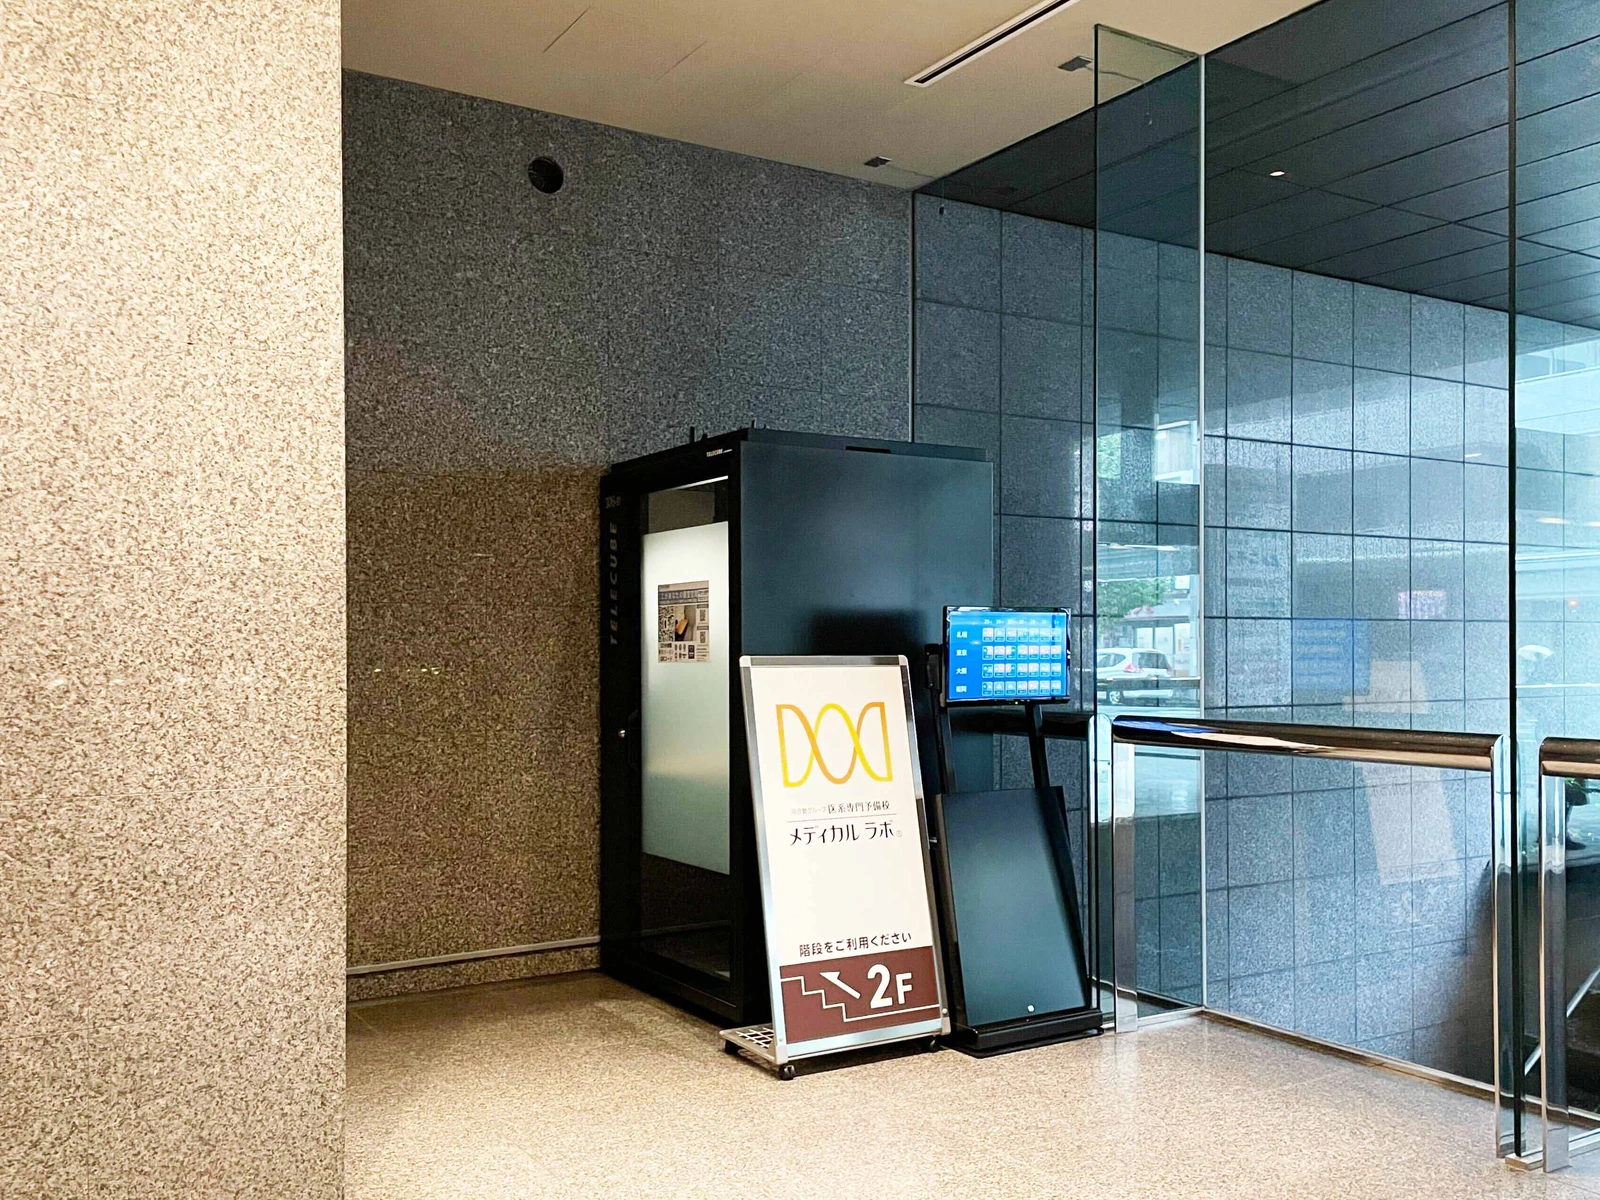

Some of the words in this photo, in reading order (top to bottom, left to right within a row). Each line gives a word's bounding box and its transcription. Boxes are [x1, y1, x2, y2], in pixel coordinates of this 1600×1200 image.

[610, 522, 618, 646] TELECUBE
[828, 800, 891, 814] 医系専門予備校
[790, 824, 860, 846] メディカル
[799, 931, 912, 957] 階段をご利用ください
[867, 963, 913, 1009] 2F
